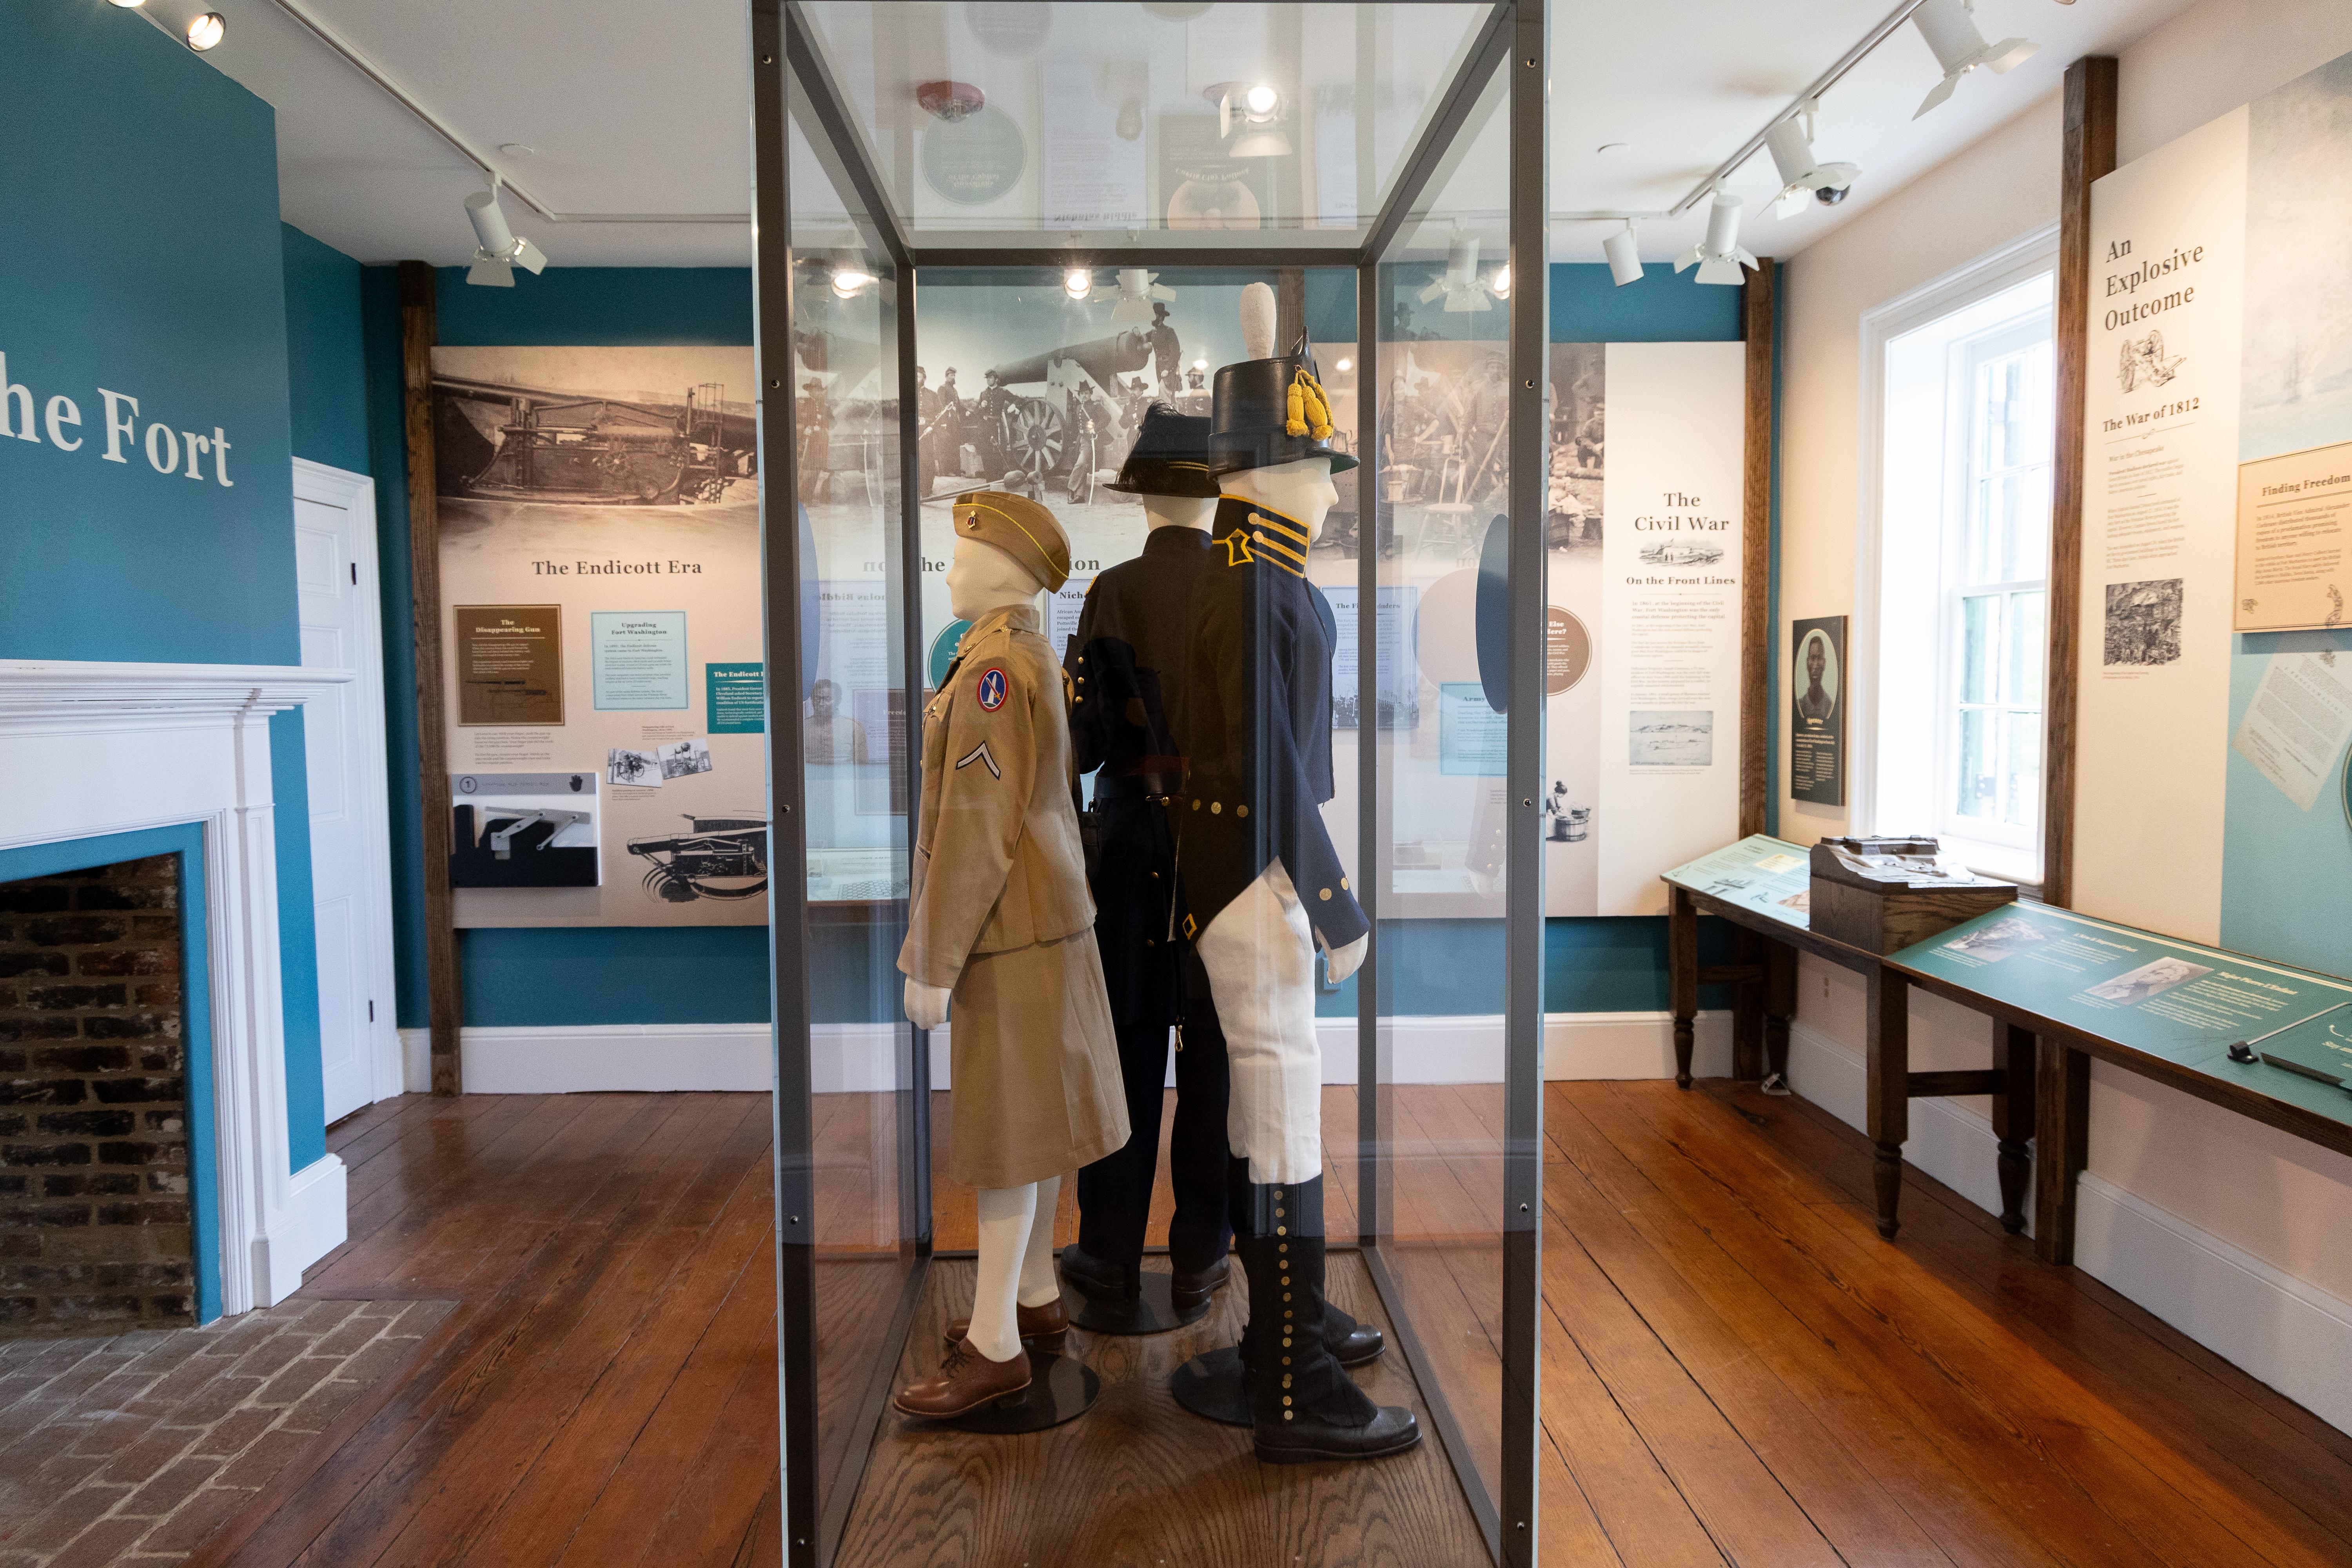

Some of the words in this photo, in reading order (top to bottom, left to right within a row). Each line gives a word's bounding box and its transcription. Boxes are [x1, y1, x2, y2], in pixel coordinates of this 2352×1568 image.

[2106, 239, 2131, 263] An
[2106, 245, 2204, 297] Explosive
[2105, 286, 2194, 331] Outcome
[0, 351, 83, 452] he
[98, 388, 234, 487] Fort
[2103, 419, 2123, 432] The
[2126, 412, 2149, 426] War
[2153, 405, 2166, 420] of
[2169, 397, 2200, 417] 1812
[2262, 482, 2300, 496] Finding
[2303, 474, 2350, 489] Freedom
[1664, 492, 1701, 507] The
[1635, 516, 1681, 531] Civil
[1688, 517, 1730, 531] War
[532, 560, 568, 575] The
[576, 560, 661, 575] Endicott
[668, 560, 702, 574] Era
[921, 557, 945, 572] he
[1626, 577, 1642, 585] On
[1704, 576, 1735, 584] Lines
